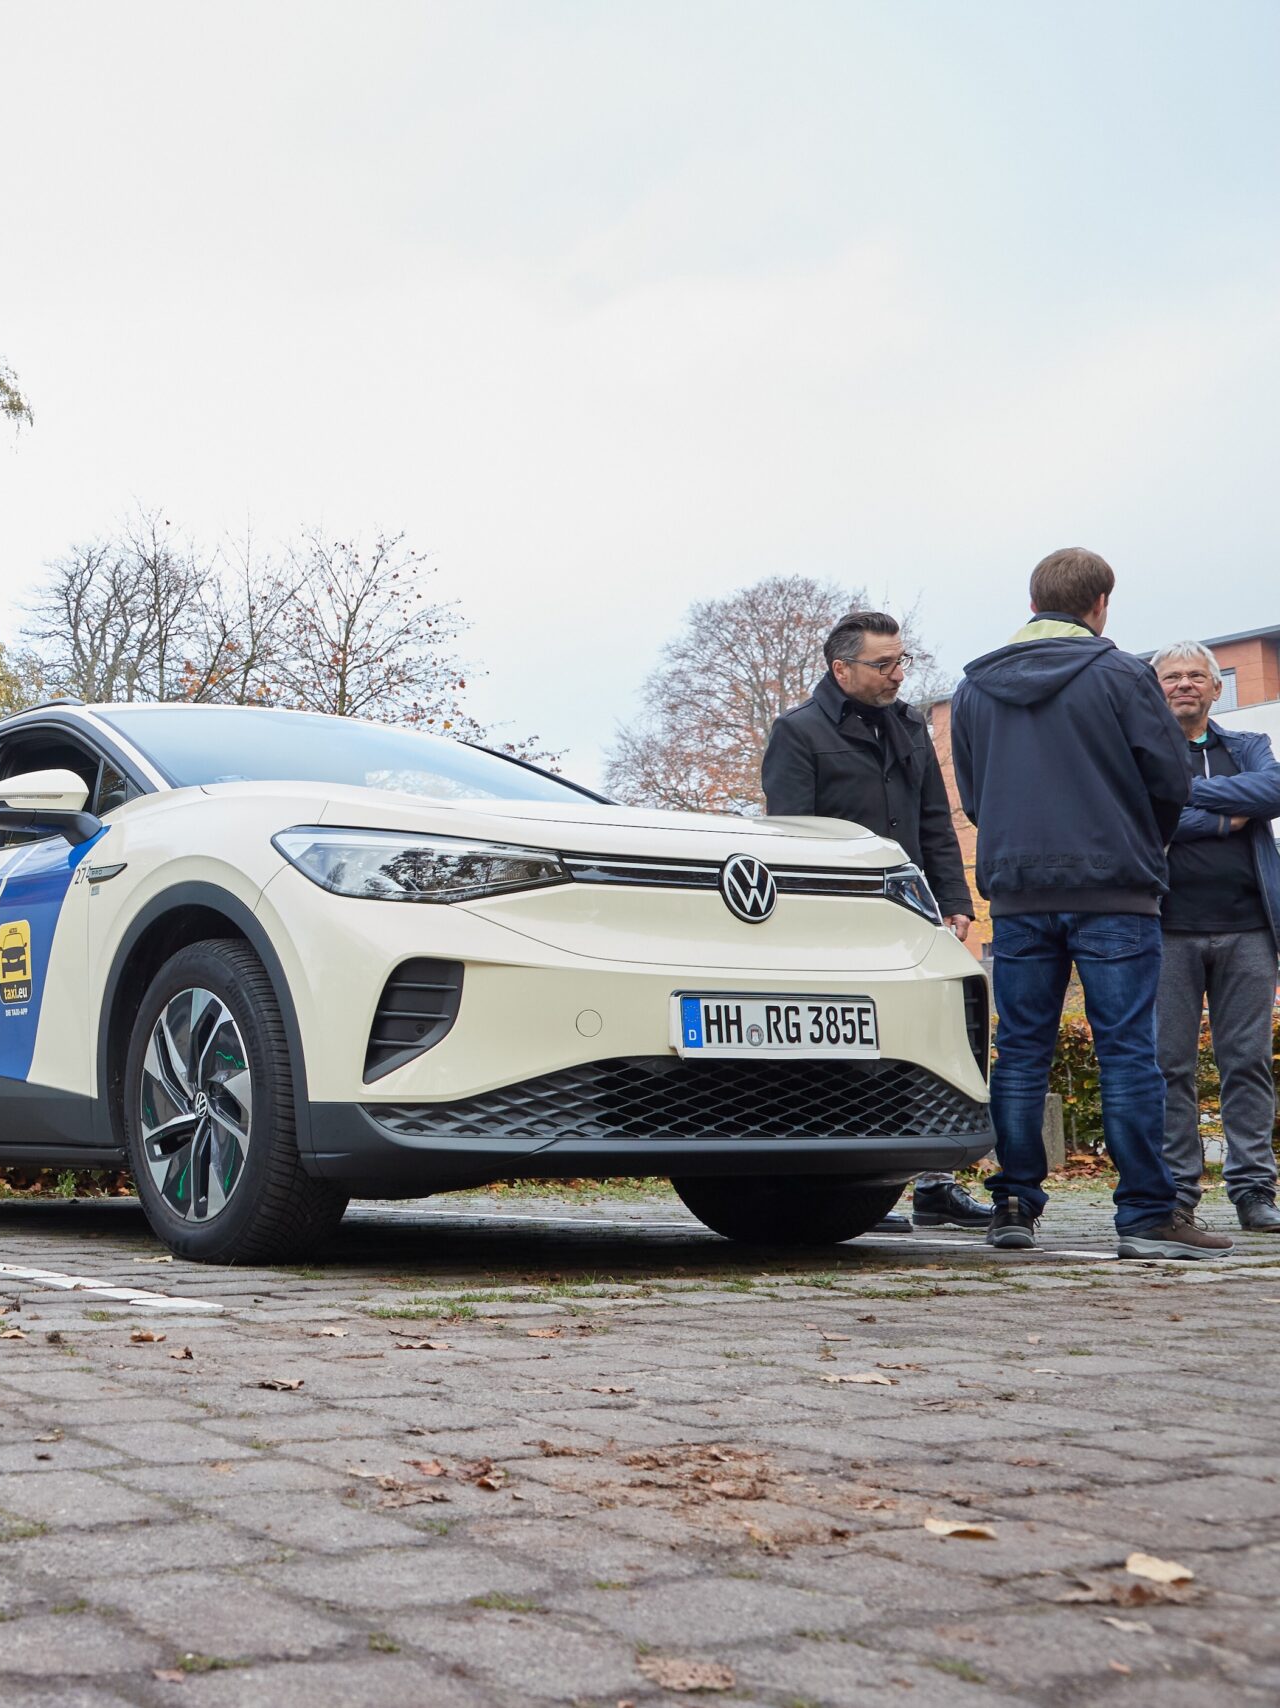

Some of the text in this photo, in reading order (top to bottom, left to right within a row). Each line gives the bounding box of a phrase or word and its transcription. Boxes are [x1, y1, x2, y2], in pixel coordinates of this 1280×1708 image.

[4, 984, 28, 1000] taxi.eu
[703, 1004, 874, 1045] HH RG 385E
[688, 1029, 697, 1041] D
